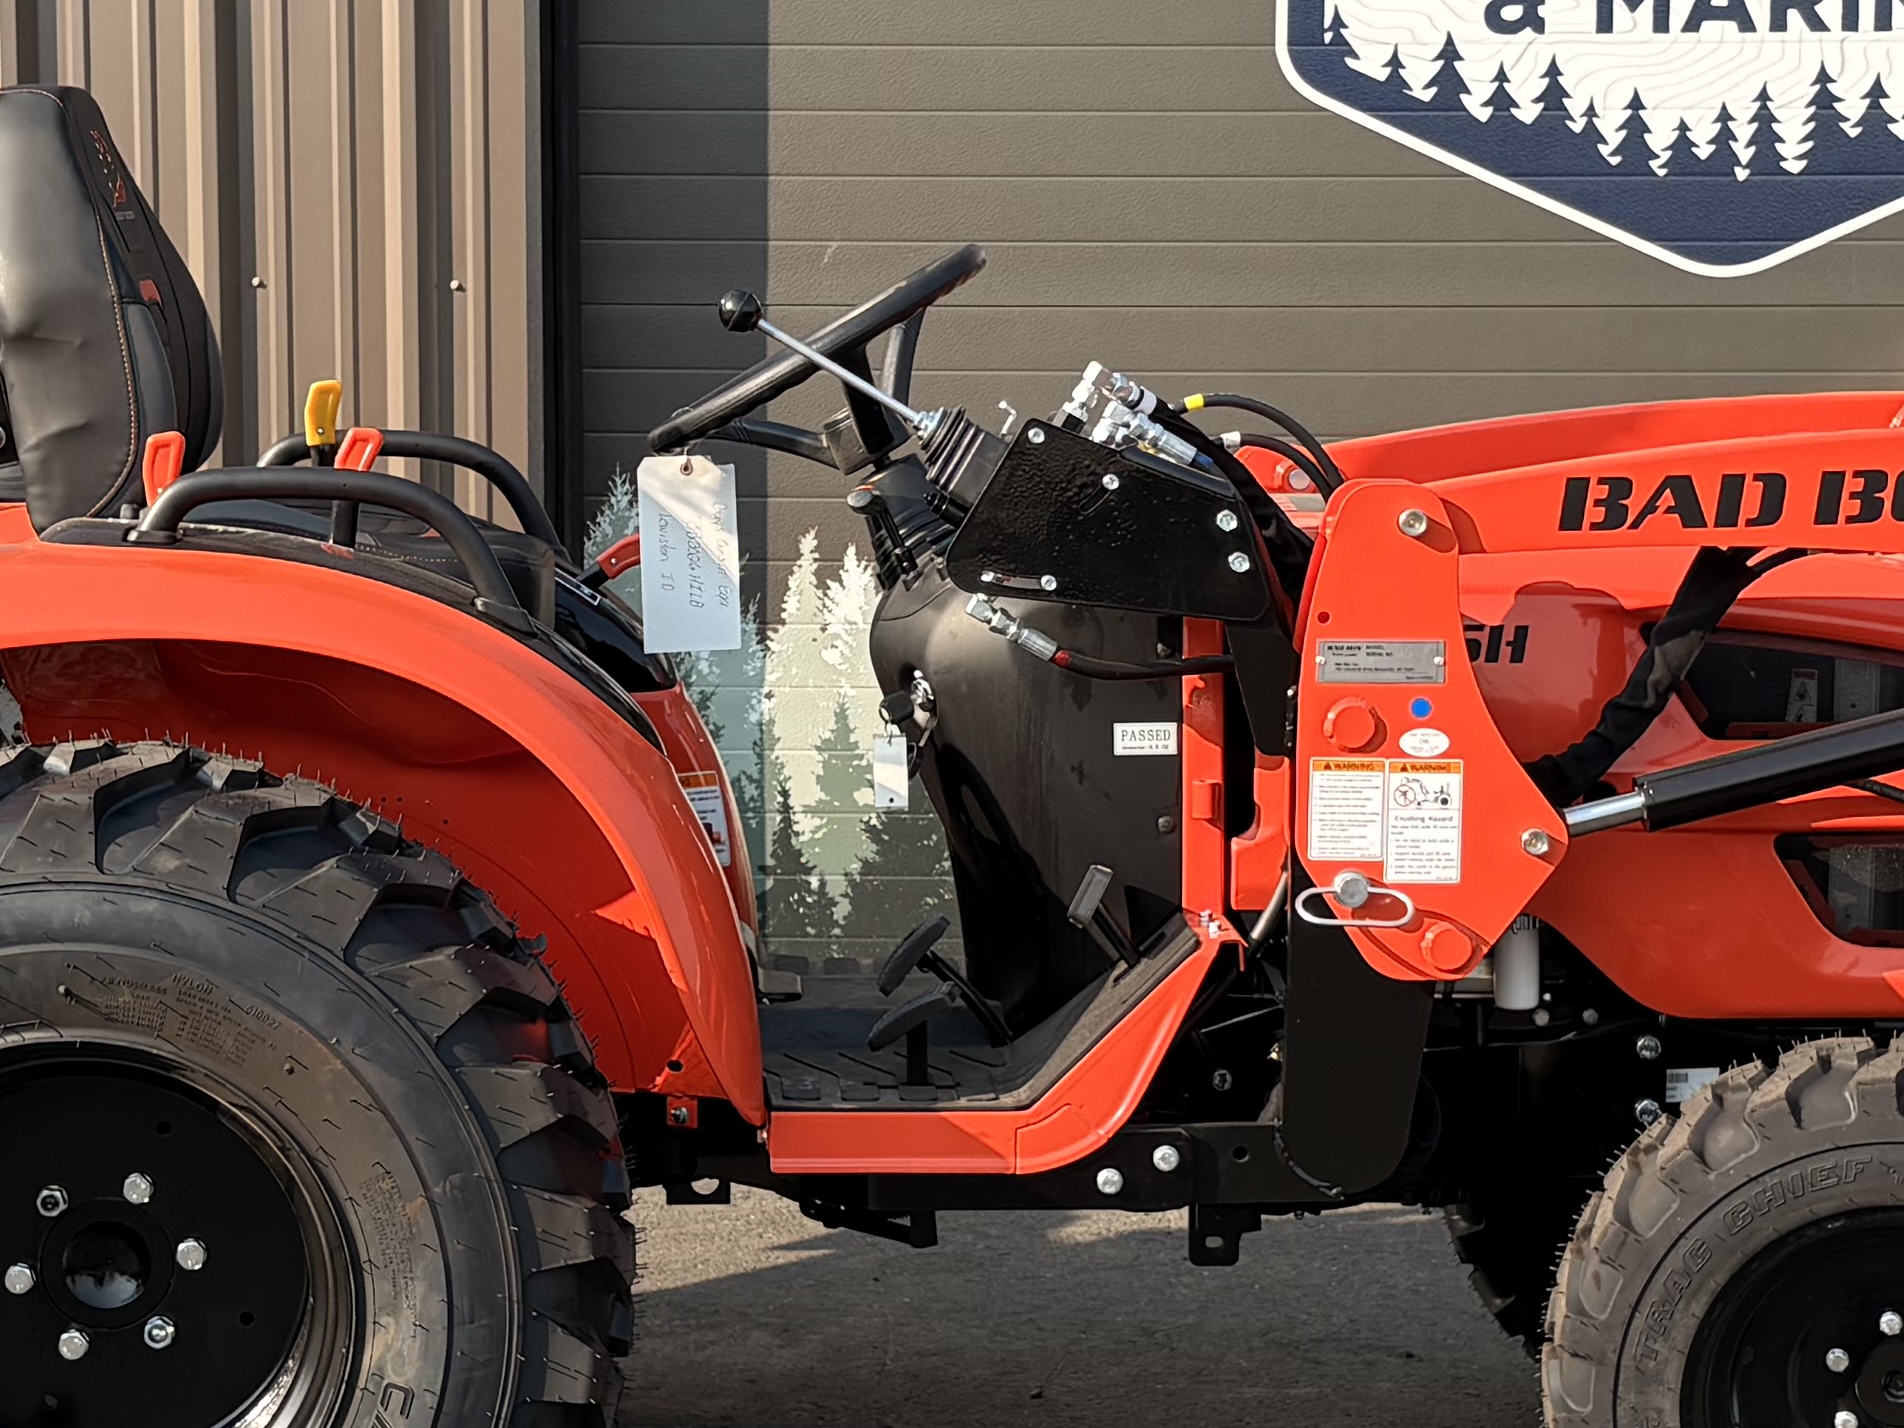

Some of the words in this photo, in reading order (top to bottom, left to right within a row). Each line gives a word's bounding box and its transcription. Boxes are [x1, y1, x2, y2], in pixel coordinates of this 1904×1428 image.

[1558, 471, 1786, 531] BAD
[1121, 730, 1170, 741] PASSED
[1334, 763, 1374, 771] WARNING
[1410, 764, 1451, 772] WARNING
[1635, 1238, 1716, 1365] TRAC
[1722, 1154, 1873, 1234] CHIEF
